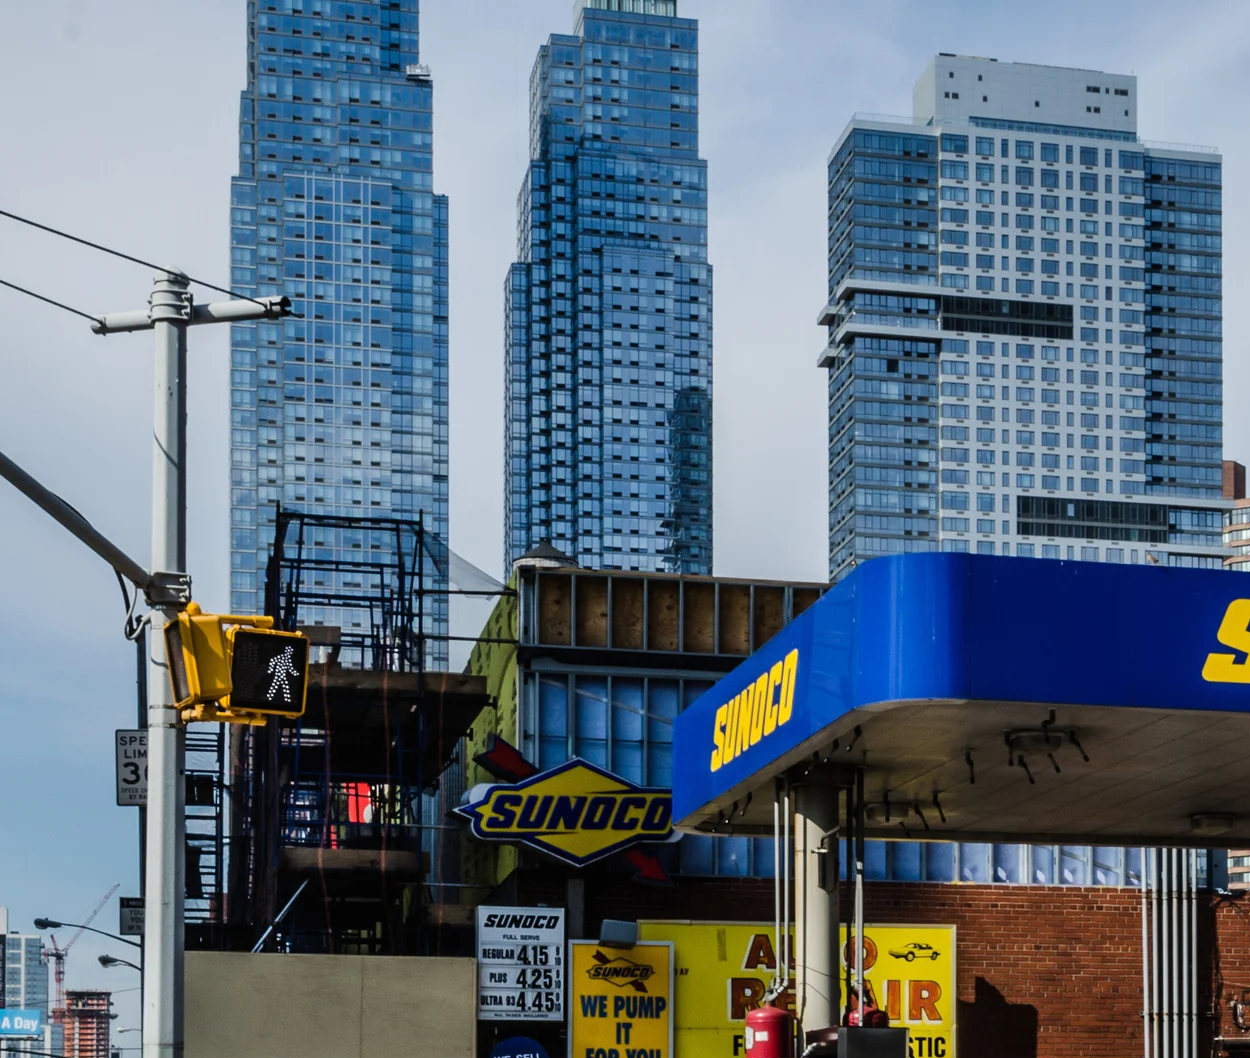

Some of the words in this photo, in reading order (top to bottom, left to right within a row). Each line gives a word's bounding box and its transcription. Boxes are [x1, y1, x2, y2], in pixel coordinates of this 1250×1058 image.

[710, 648, 798, 773] SUNOCO
[486, 794, 673, 831] SUNOCO
[484, 914, 560, 929] SUNOCO
[482, 948, 515, 960] REGULAR
[516, 945, 549, 966] 4.15
[742, 933, 878, 972] AUO
[490, 972, 508, 984] PLUS
[516, 968, 553, 989] 4.25
[592, 966, 652, 979] SUNOCO
[480, 995, 503, 1006] ULTRA
[506, 996, 516, 1006] 93
[516, 992, 554, 1012] 4.45
[580, 995, 608, 1018] WE
[614, 996, 667, 1019] PUMP
[728, 977, 943, 1023] REAIR
[2, 1018, 10, 1029] A
[14, 1017, 38, 1032] Day
[615, 1022, 632, 1045] IT
